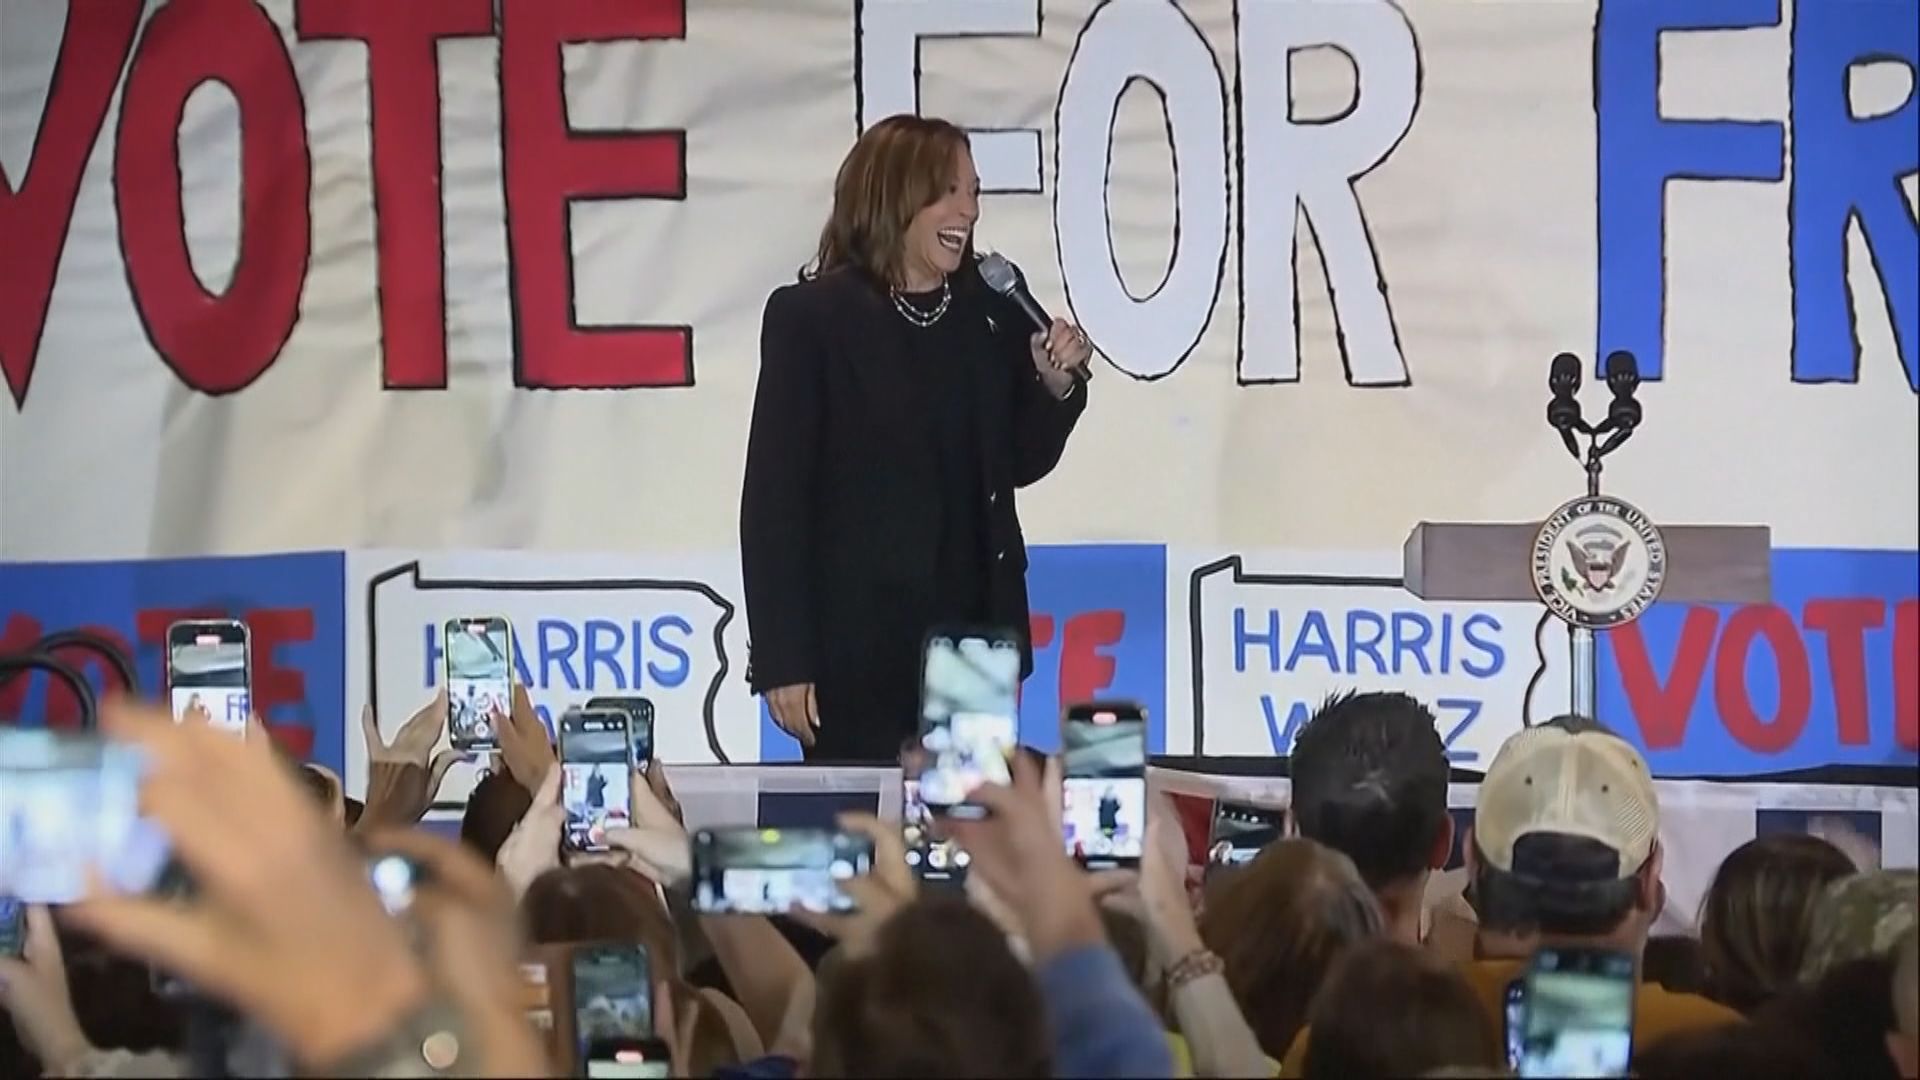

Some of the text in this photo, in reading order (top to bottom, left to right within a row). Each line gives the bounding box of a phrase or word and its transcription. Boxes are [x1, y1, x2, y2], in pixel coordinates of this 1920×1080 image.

[854, 0, 1420, 387] FOR
[1233, 607, 1505, 678] HARRIS
[1260, 695, 1482, 761] WZ
